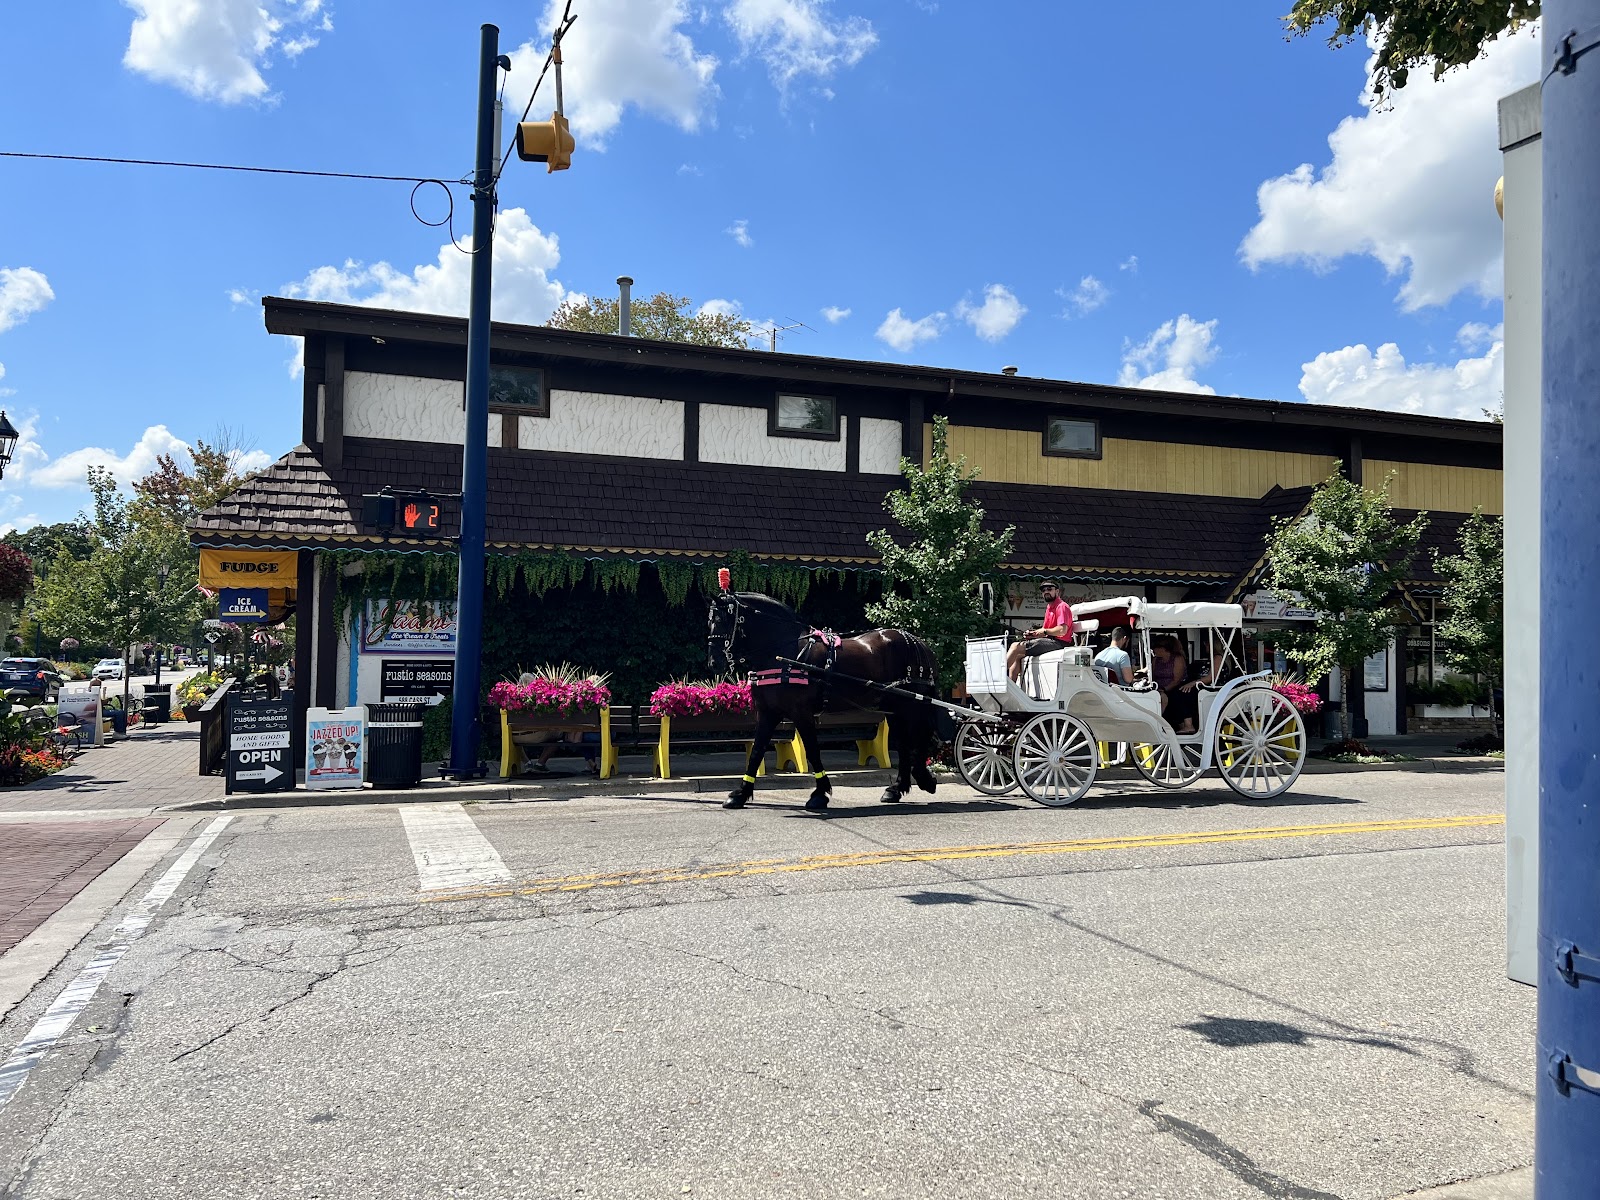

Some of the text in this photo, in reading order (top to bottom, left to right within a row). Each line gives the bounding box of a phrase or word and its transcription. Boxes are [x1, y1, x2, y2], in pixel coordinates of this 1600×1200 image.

[429, 505, 438, 527] 2
[220, 562, 278, 573] FUDGE
[391, 632, 402, 640] Ice
[386, 669, 452, 681] rustic seasons
[312, 725, 359, 740] JAZZED UP!
[239, 750, 281, 763] OPEN
